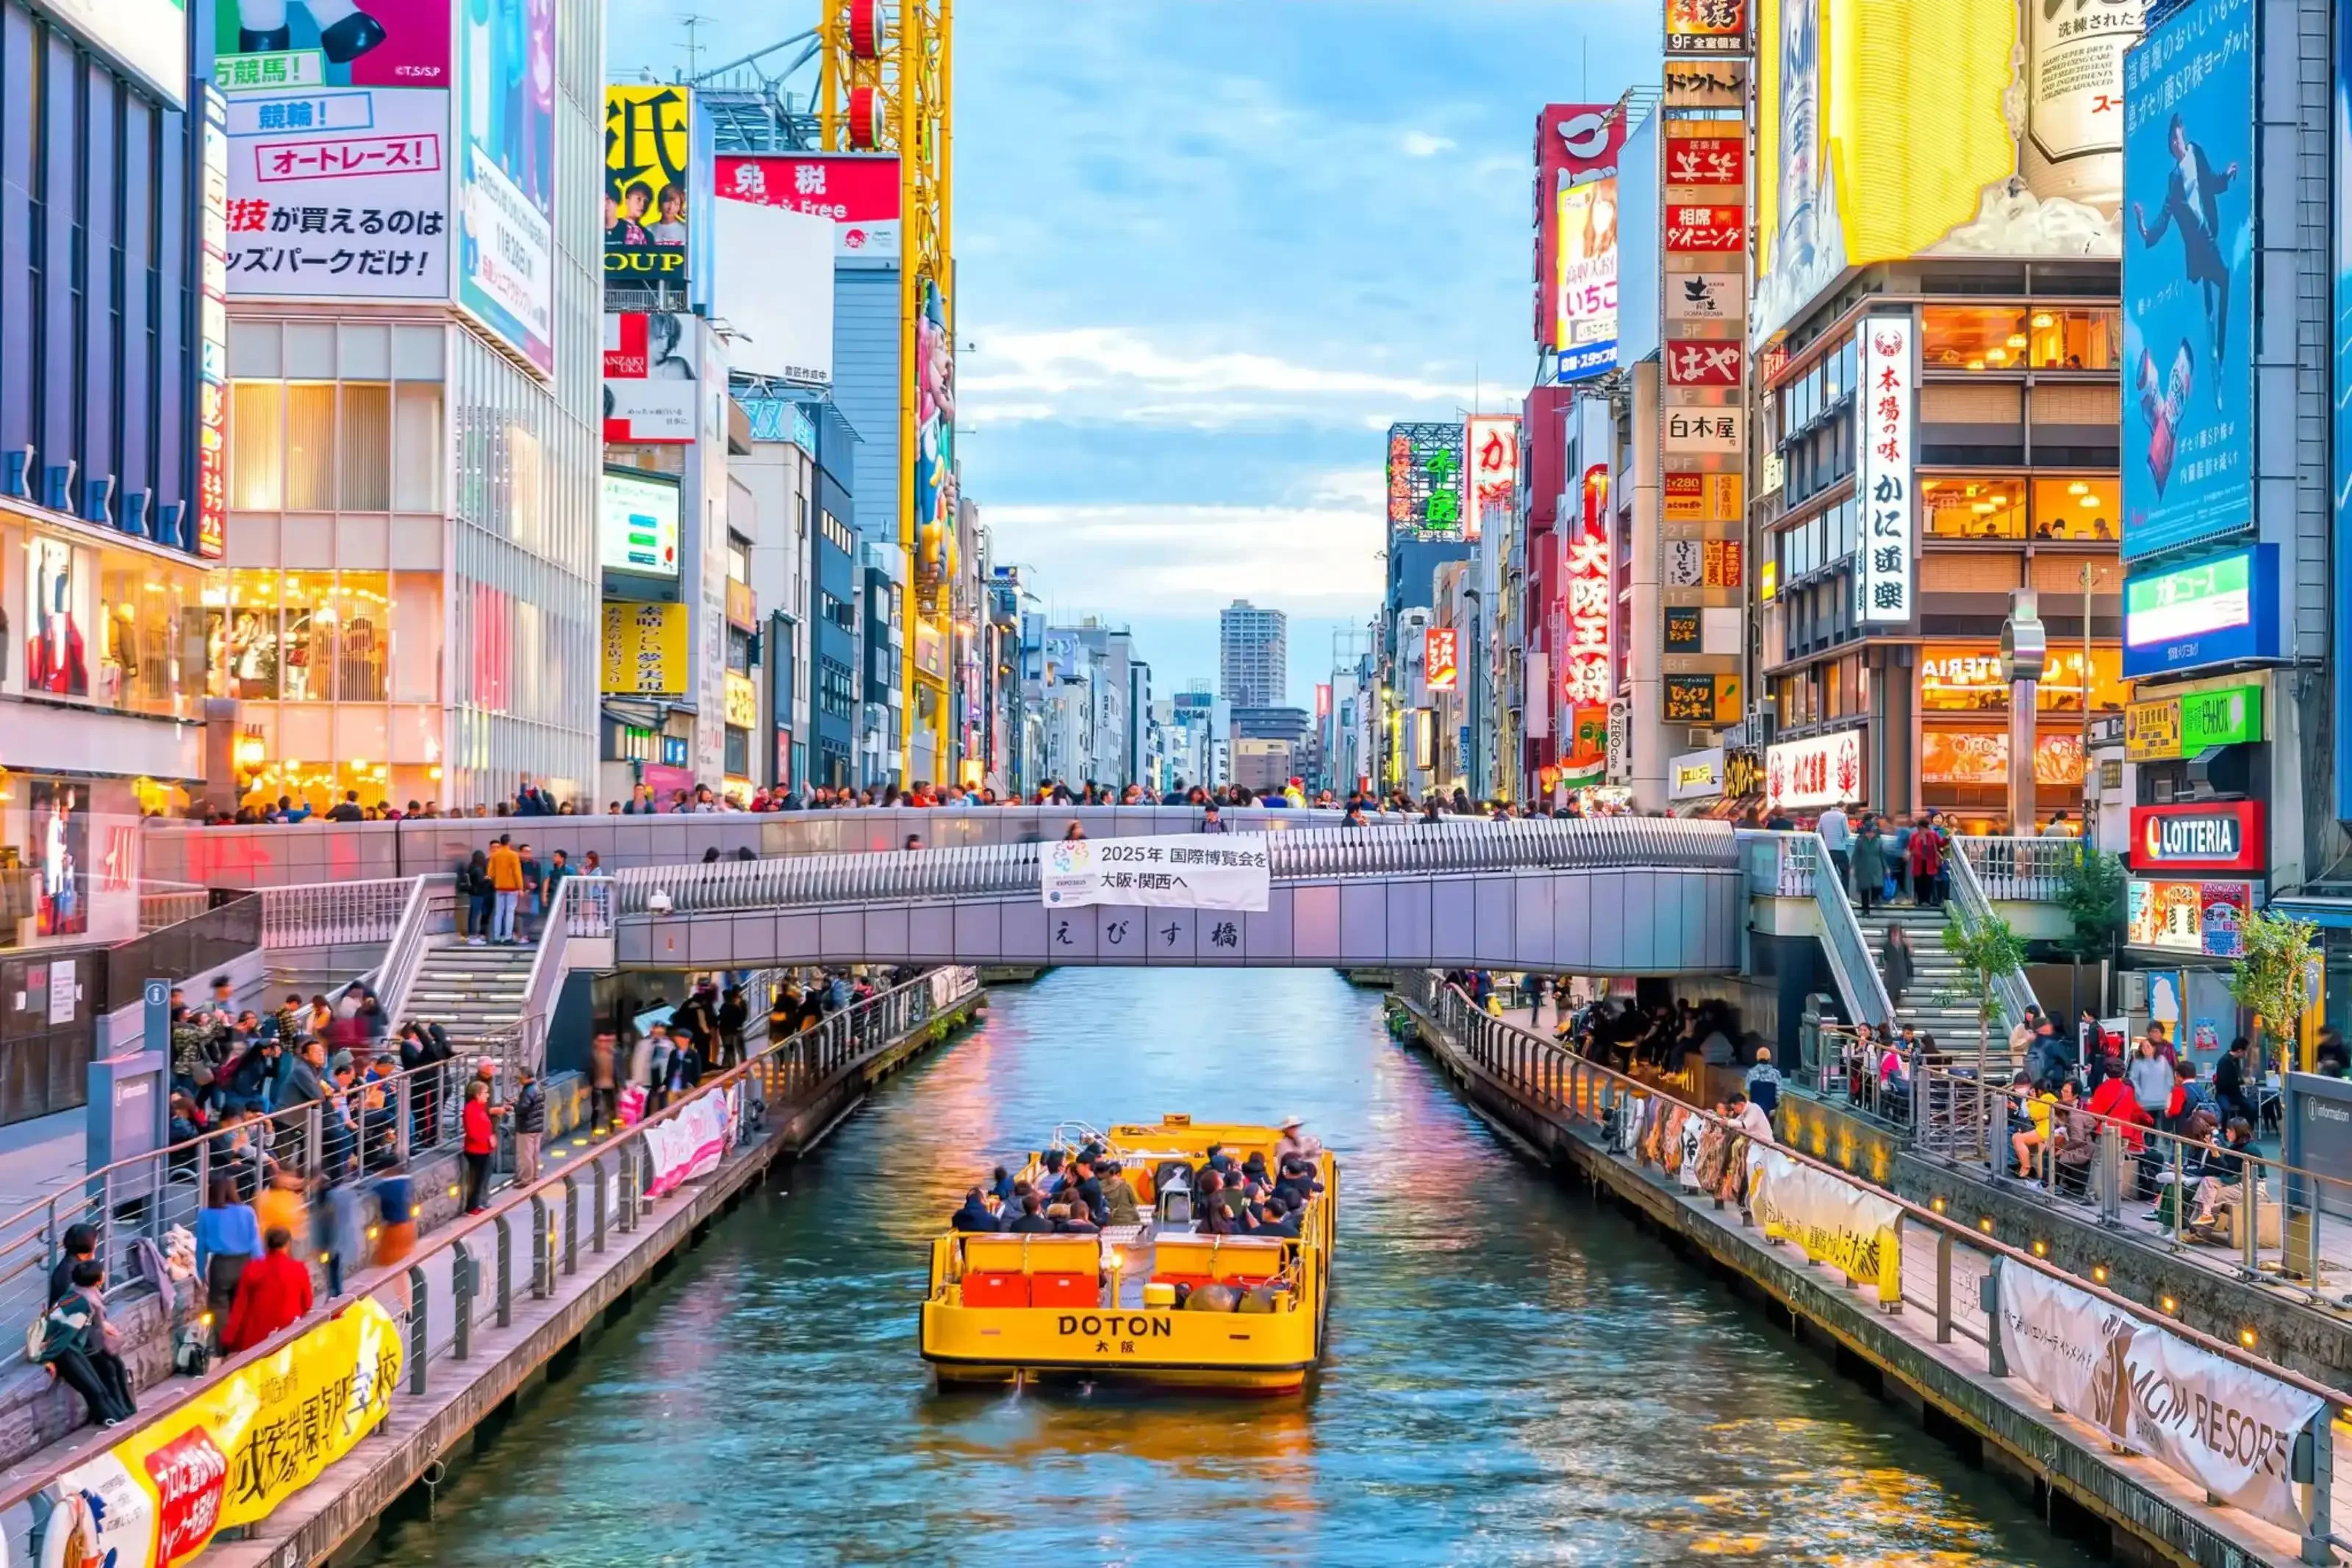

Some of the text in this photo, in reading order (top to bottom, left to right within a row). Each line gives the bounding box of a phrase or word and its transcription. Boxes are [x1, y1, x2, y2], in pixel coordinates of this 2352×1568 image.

[272, 141, 423, 174] オートレース!
[1679, 208, 1711, 226] 相席
[1667, 226, 1743, 248] ダイニング
[1876, 365, 1901, 463] 本場の味
[1669, 414, 1735, 439] 白木屋
[1874, 475, 1904, 611] かに道楽
[1670, 684, 1710, 702] びっくり
[1669, 702, 1712, 718] ドンキー
[2162, 819, 2232, 853] LOTTERIA
[1101, 846, 1267, 868] 2025年 国際博覧会を
[1100, 871, 1188, 891] 大阪・関西へ
[1055, 920, 1238, 948] えびす橋
[2317, 1104, 2349, 1123] information
[1058, 1315, 1171, 1337] DOTON
[1096, 1339, 1136, 1353] 大阪
